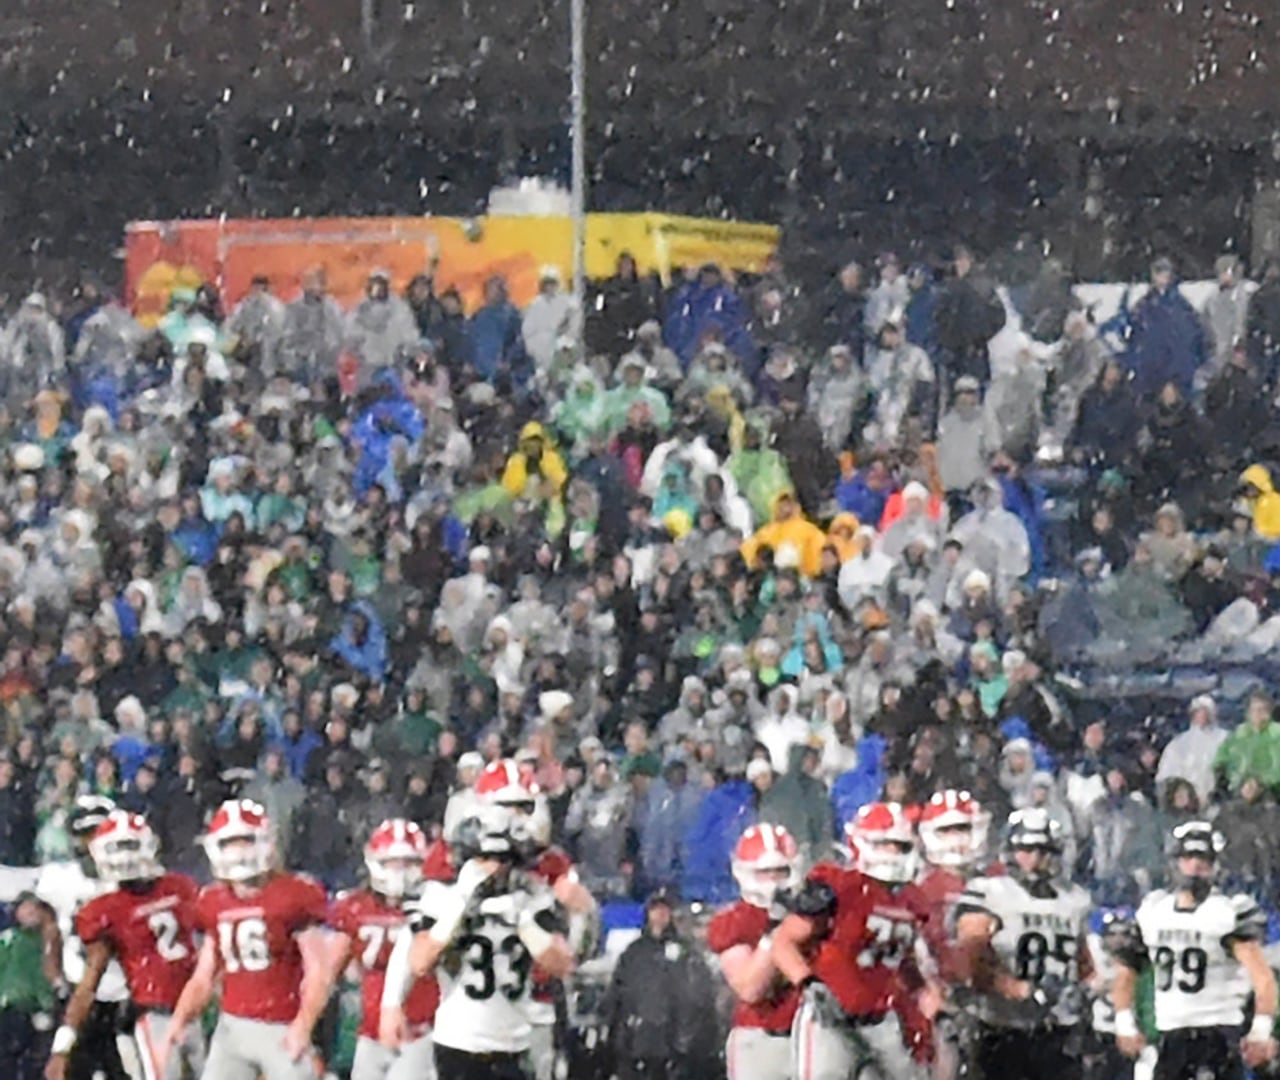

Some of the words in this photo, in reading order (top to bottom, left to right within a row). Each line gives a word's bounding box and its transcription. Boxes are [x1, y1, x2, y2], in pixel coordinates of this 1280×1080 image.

[149, 911, 187, 961] 2
[217, 919, 270, 972] 16
[457, 934, 532, 1000] 33
